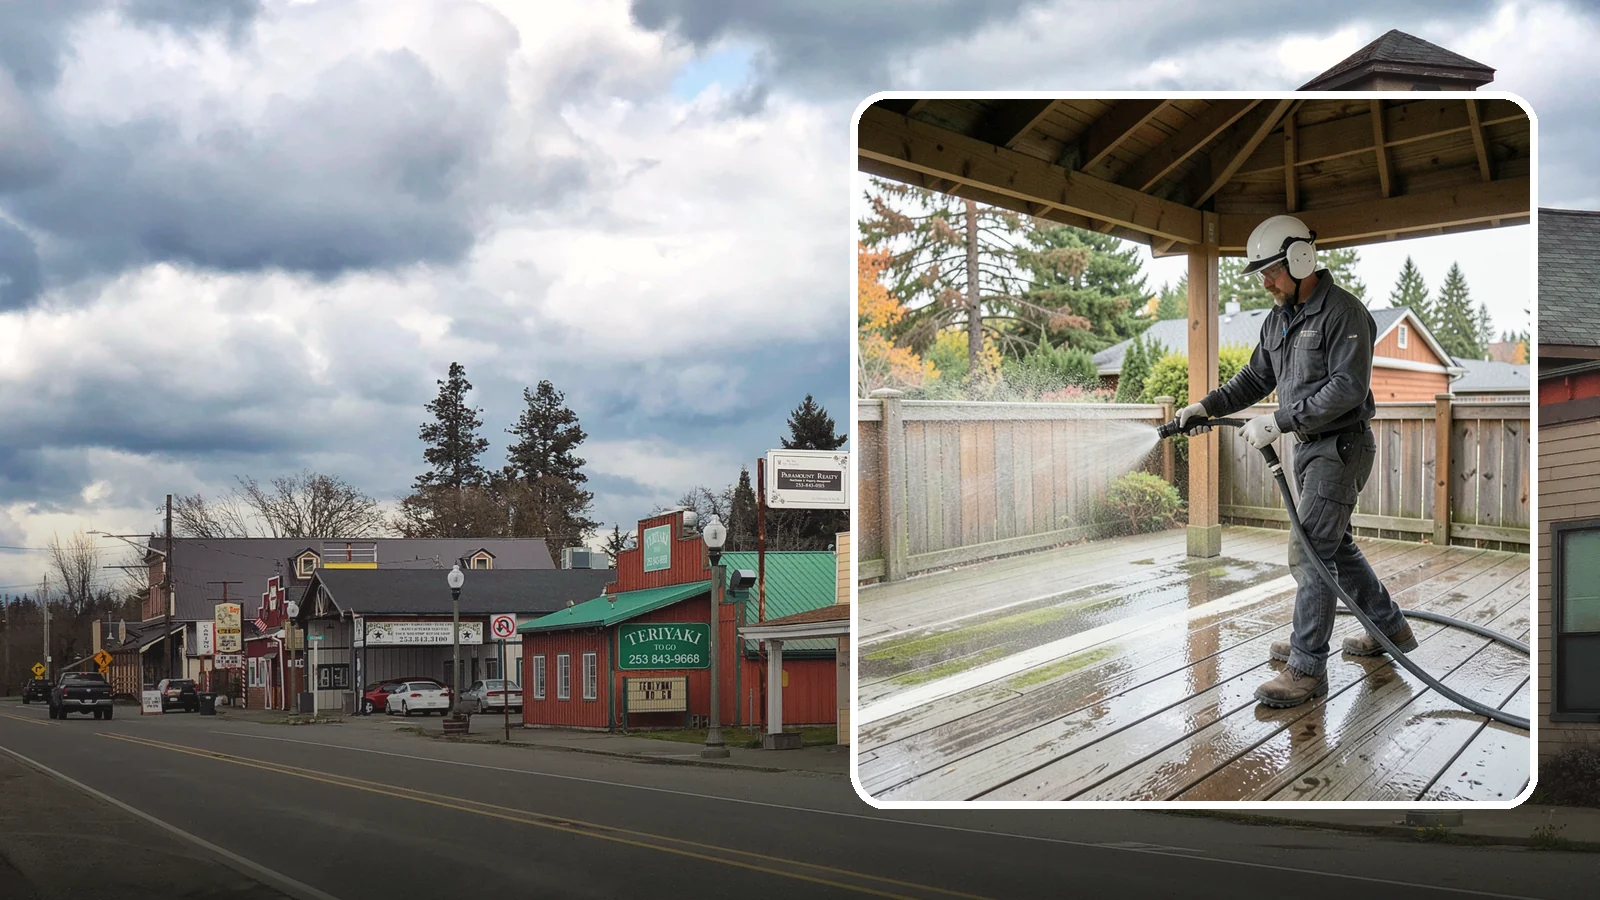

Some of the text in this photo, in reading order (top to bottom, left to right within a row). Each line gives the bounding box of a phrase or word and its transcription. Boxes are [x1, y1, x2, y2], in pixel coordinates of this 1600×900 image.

[625, 627, 702, 645] TERIYAKI
[629, 654, 700, 664] 253 843-9668
[639, 681, 673, 691] TERIYAKI
